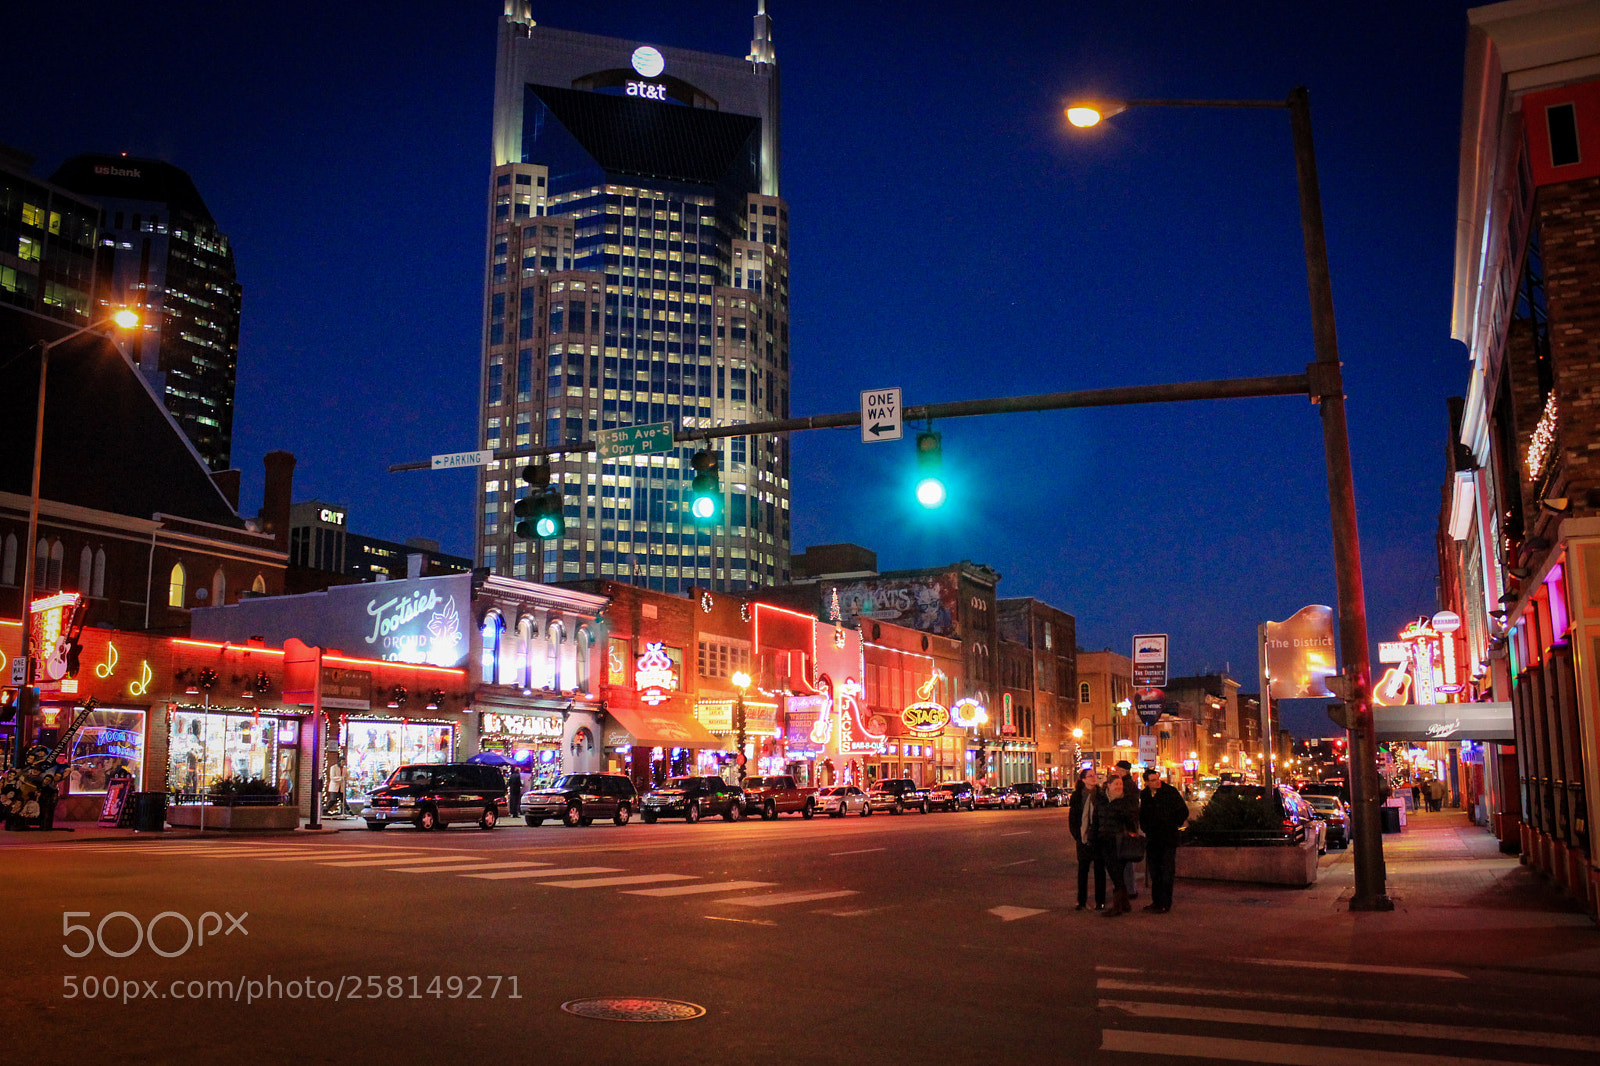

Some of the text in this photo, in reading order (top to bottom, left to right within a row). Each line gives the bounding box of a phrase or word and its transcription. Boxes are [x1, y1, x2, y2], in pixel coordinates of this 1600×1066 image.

[626, 81, 667, 101] at&t
[868, 393, 894, 406] ONE
[868, 406, 895, 420] WAY
[611, 440, 653, 455] Opry Pl
[443, 453, 481, 467] PARKING
[320, 509, 345, 525] CMT
[365, 588, 443, 643] Tootsies
[383, 634, 428, 649] ORCHID
[1270, 635, 1333, 649] The District
[905, 708, 947, 727] STAGE
